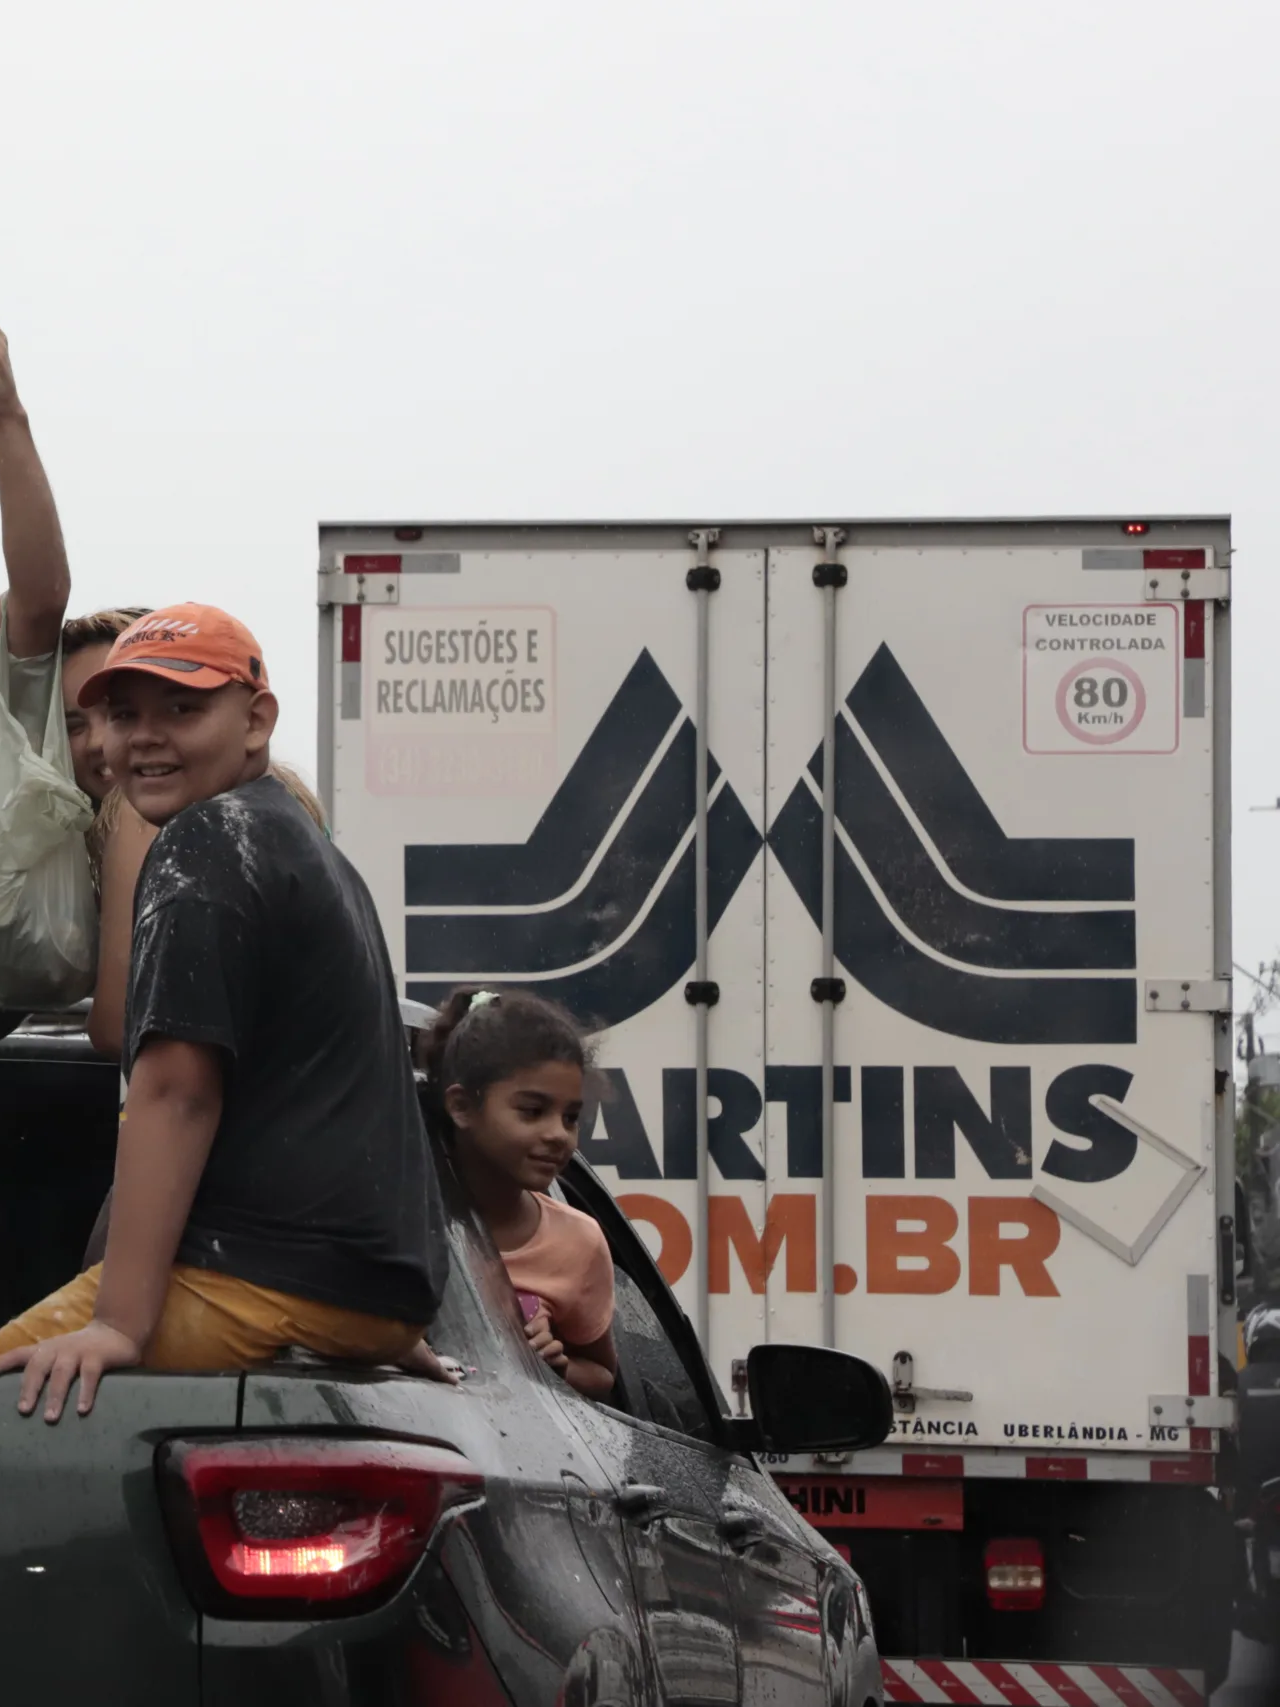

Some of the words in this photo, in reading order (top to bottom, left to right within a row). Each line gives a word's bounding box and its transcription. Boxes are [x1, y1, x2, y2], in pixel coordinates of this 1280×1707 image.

[1045, 613, 1157, 627] VELOCIDADE
[384, 619, 518, 665] SUGESTÕES
[527, 629, 538, 663] E
[1035, 637, 1166, 651] CONTROLADA
[377, 669, 546, 724] RECLAMAÇÕES
[1073, 676, 1128, 708] 80
[1077, 711, 1124, 724] Km/h
[577, 1063, 1139, 1183] ARTINS
[614, 1193, 1062, 1297] OM.BR
[1003, 1422, 1128, 1441] UBERLÂNDIA
[1150, 1427, 1180, 1442] MG
[782, 1486, 866, 1514] HINI
